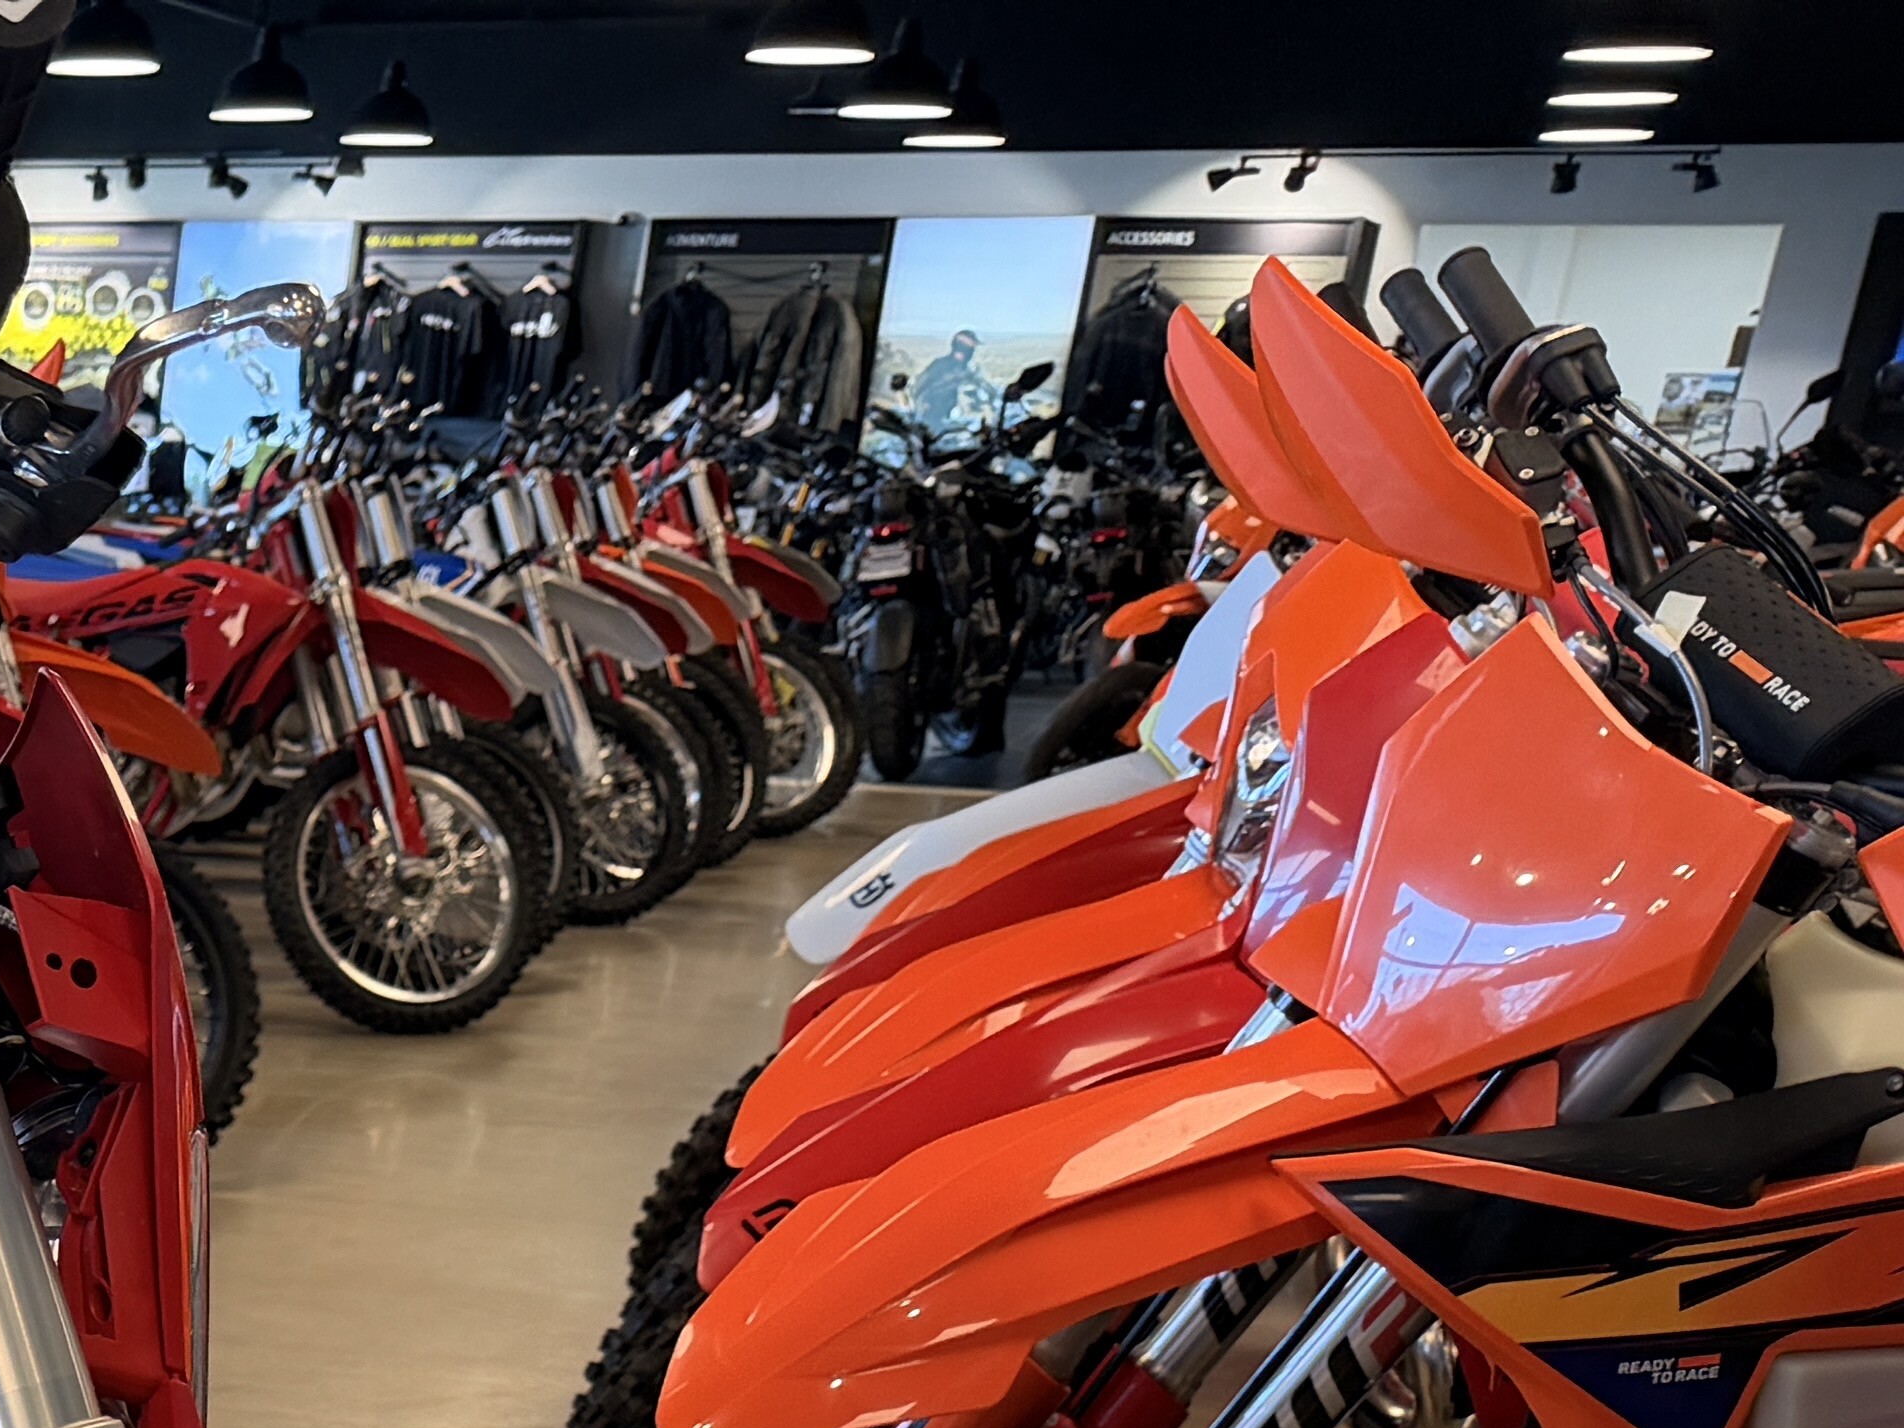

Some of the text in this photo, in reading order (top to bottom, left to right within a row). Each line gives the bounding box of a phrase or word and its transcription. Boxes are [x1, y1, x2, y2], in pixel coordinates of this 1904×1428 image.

[1106, 230, 1196, 247] ACCESSORIES
[1710, 633, 1738, 659] TO
[1762, 676, 1812, 713] RACE
[1617, 1358, 1675, 1375] READY
[1652, 1366, 1720, 1384] TO RACE
